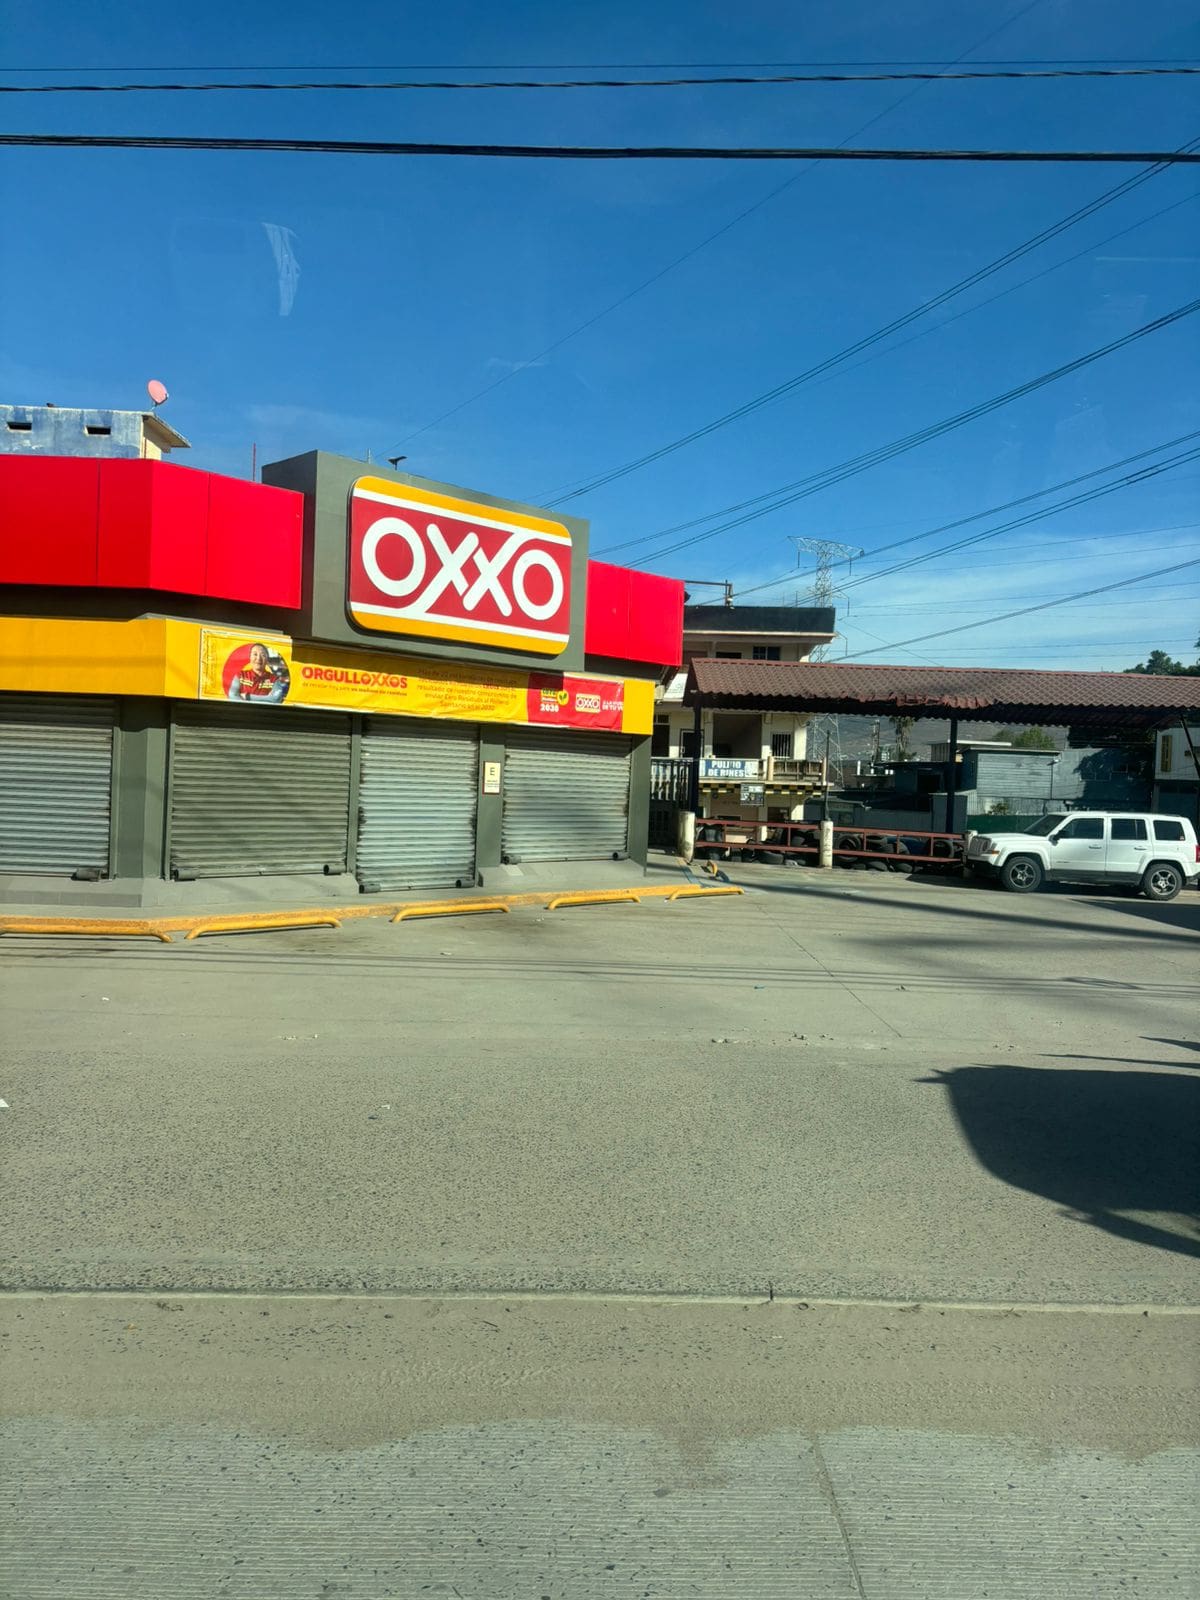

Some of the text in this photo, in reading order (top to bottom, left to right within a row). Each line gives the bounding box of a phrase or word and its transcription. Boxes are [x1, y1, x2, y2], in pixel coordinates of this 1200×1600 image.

[361, 516, 564, 621] OXXO
[301, 666, 408, 689] ORGULLOXXOS
[576, 697, 600, 710] OXXO
[708, 768, 720, 777] DE
